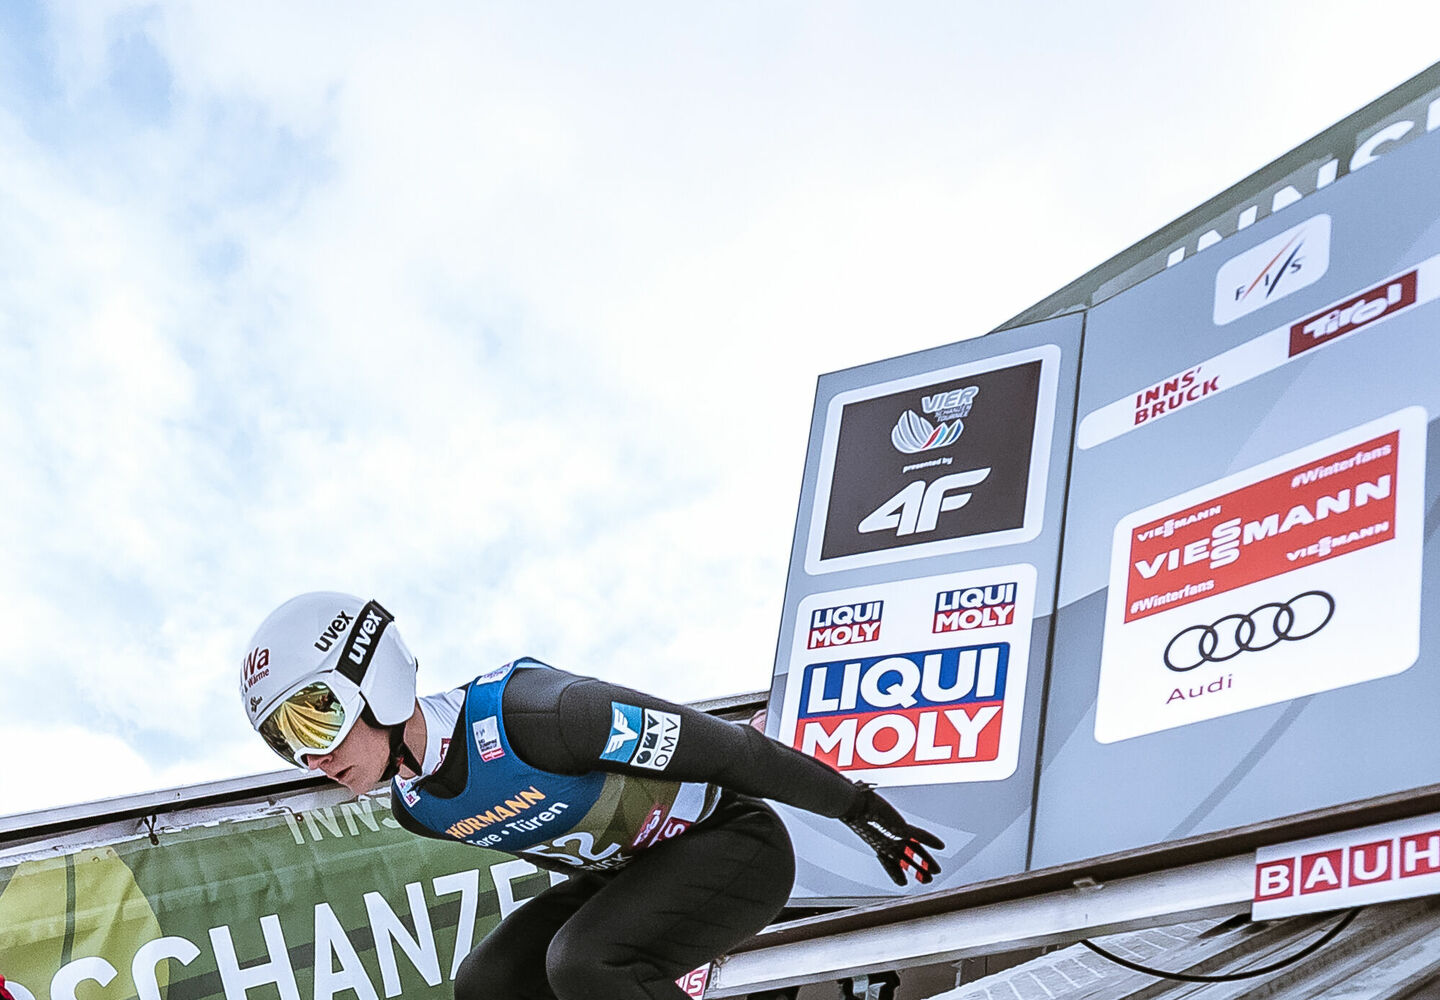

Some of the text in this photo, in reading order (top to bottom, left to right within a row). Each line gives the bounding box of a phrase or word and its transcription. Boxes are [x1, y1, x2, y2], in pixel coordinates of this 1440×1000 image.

[1303, 284, 1402, 338] Tirol
[922, 386, 979, 413] VIER
[1134, 375, 1220, 425] BRUCK
[1291, 445, 1392, 488] #Winterfans
[858, 467, 992, 537] 4F
[812, 601, 881, 628] LIQUI
[937, 583, 1014, 612] LIQUI
[1130, 579, 1215, 614] #Winterfans
[314, 610, 354, 652] uvex
[348, 610, 383, 665] uvex
[809, 621, 880, 648] MOLY
[934, 604, 1014, 633] MOLY
[807, 647, 1000, 714] LIQUI
[1166, 674, 1233, 704] Audi
[654, 717, 679, 768] OMV
[801, 705, 1002, 767] MOLY
[509, 802, 569, 833] Türen
[1259, 835, 1440, 897] BAUH
